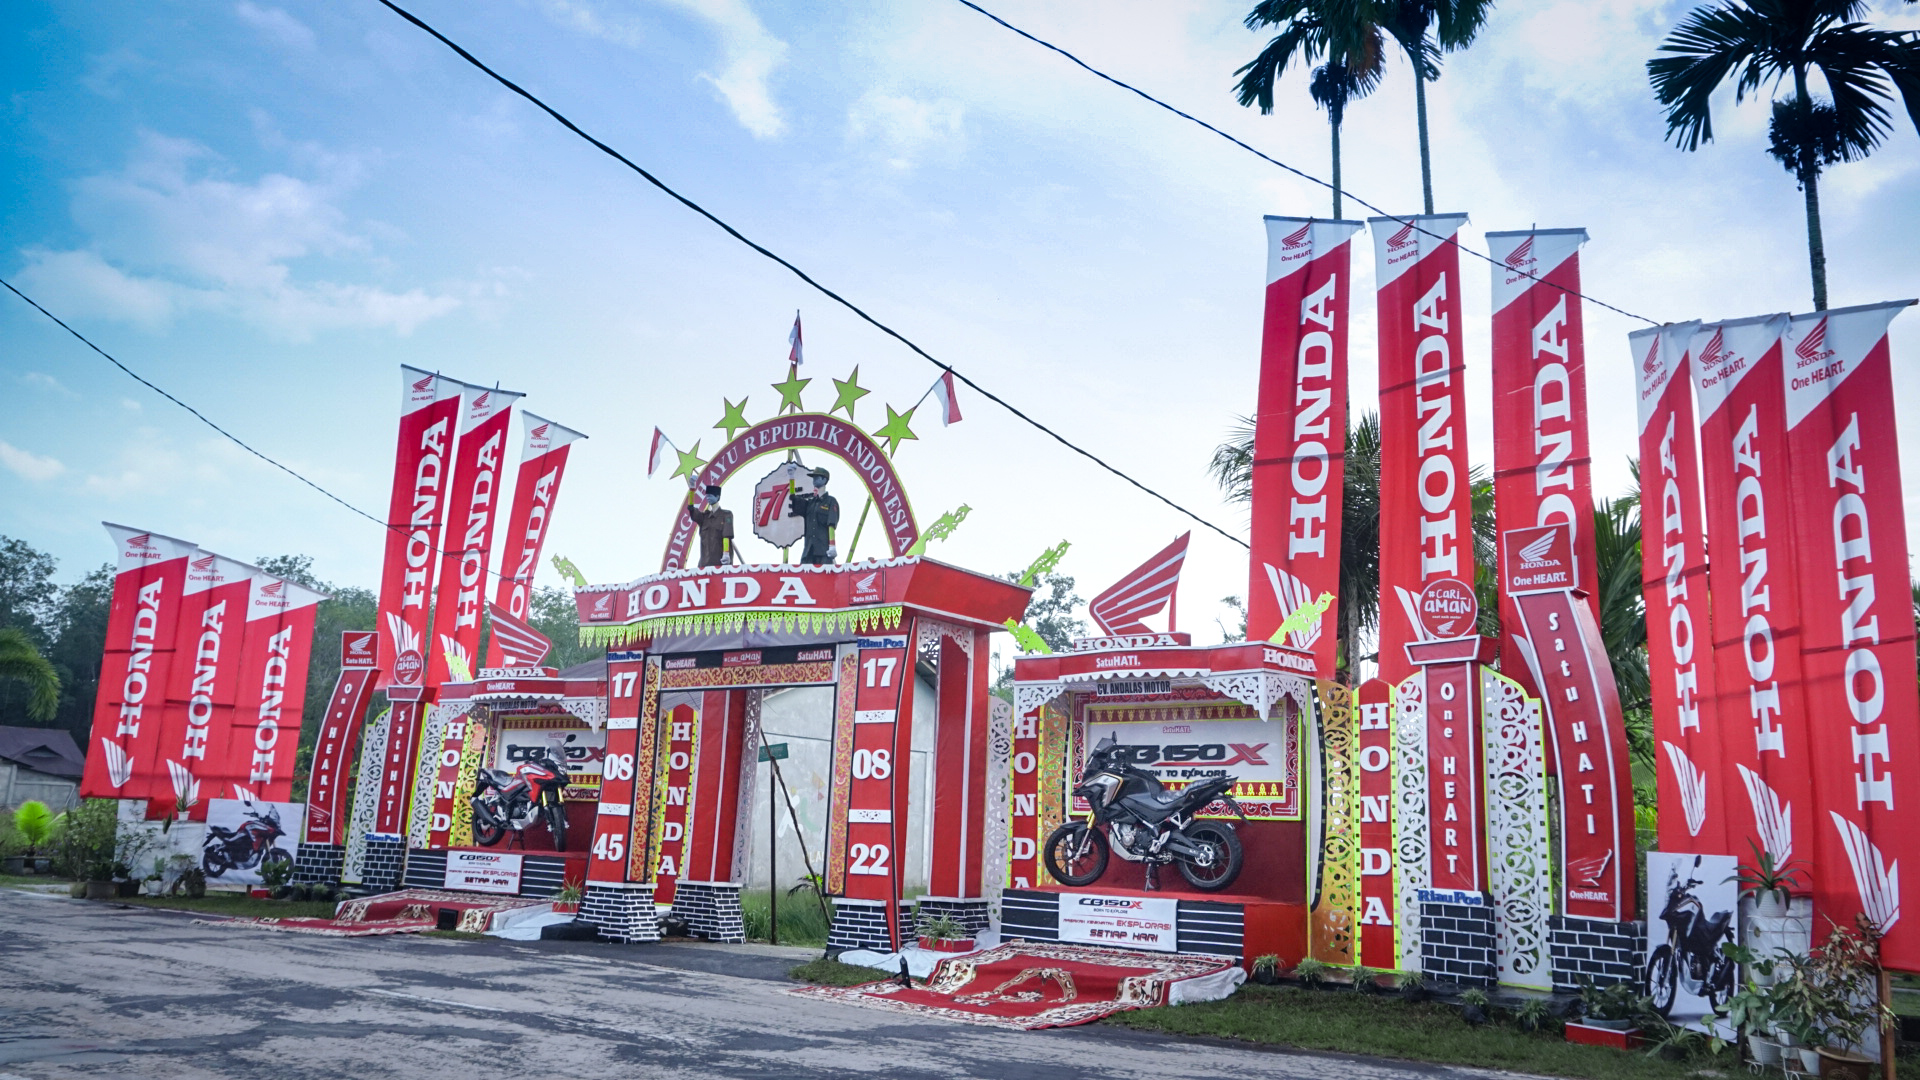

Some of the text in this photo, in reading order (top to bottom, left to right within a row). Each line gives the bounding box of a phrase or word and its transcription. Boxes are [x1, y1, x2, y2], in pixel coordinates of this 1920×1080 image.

[1282, 240, 1312, 251] HONDA
[1388, 240, 1418, 253] HONDA
[1702, 358, 1746, 388] One HEART.
[1703, 350, 1735, 372] HONDA
[1791, 360, 1846, 391] One HEART.
[1796, 349, 1836, 368] HONDA
[1288, 274, 1336, 560] HONDA
[1414, 272, 1458, 581] HONDA
[1532, 293, 1577, 544] ONDA
[402, 416, 448, 610] HONDA
[666, 420, 914, 571] DIRGHAYU REPUBLIK INDONESIA
[758, 483, 791, 527] 77
[454, 429, 502, 632] HONDA
[509, 466, 558, 620] ONDA
[1513, 572, 1568, 586] One HEART.
[1520, 560, 1562, 570] HONDA
[1660, 411, 1700, 736] HONDA
[1732, 404, 1785, 760] HONDA
[627, 576, 816, 618] HONDA
[1827, 412, 1894, 811] HONDA
[116, 577, 163, 738] HONDA
[1074, 634, 1178, 650] HONDA
[1263, 648, 1318, 672] HONDA
[182, 600, 226, 761] HONDA
[478, 668, 546, 678] HONDA
[612, 672, 638, 698] 17
[863, 658, 897, 688] 17
[1097, 680, 1171, 695] CV. ANDALAS MOTOR
[250, 625, 292, 785] HONDA
[1549, 612, 1596, 834] Satu HATI
[318, 683, 352, 802] One HEART
[384, 710, 405, 826] Satu HATI
[603, 753, 634, 781] 08
[852, 748, 892, 780] 08
[1181, 768, 1227, 779] EXPLORE
[1440, 682, 1458, 874] One HEART
[431, 722, 465, 848] HOND
[656, 722, 691, 876] HONDA
[1360, 702, 1392, 926] HONDA
[592, 833, 624, 862] 45
[850, 843, 890, 876] 22
[1079, 898, 1143, 909] CB150X
[1090, 929, 1159, 942] SETIAP HARI
[1116, 920, 1172, 930] EKSPLORASI
